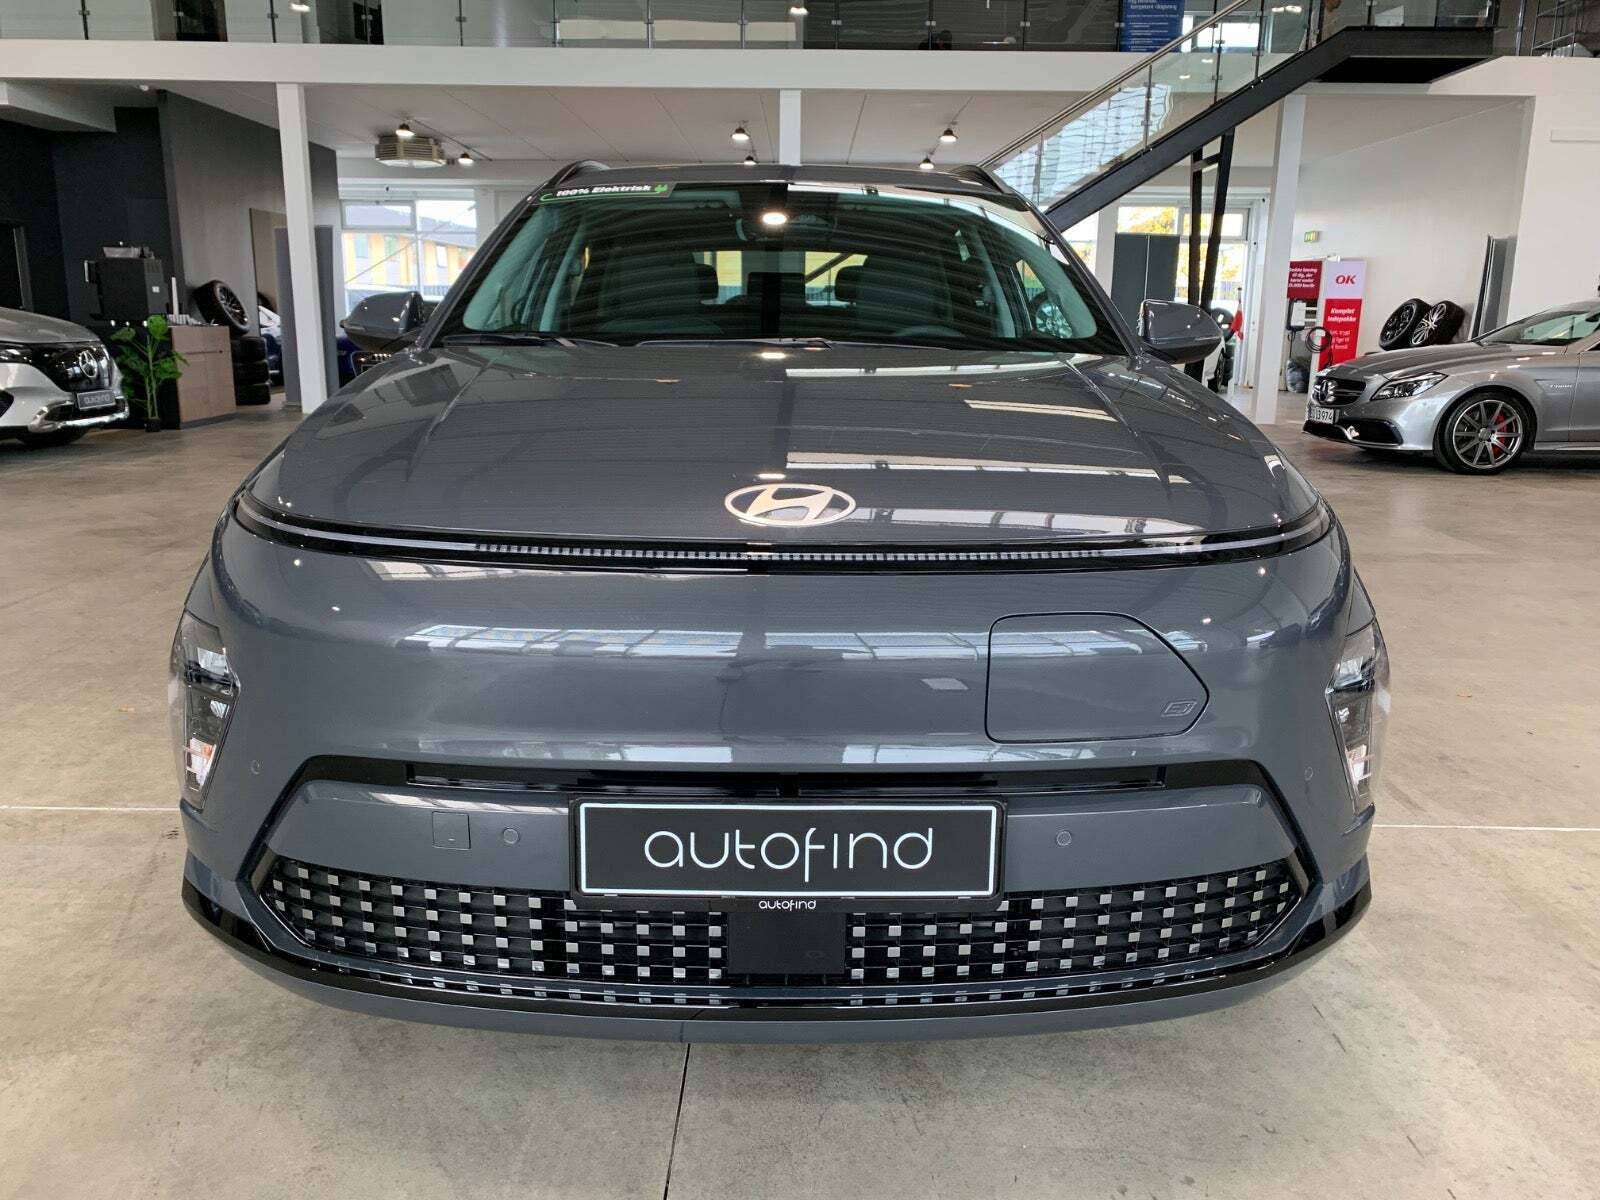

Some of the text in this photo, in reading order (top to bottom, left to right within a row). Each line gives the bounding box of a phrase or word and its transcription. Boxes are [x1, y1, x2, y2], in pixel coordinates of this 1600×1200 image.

[557, 184, 652, 197] 100% Elektrisk
[1335, 275, 1357, 285] OK
[644, 827, 933, 883] autofind
[758, 899, 817, 912] autofind
